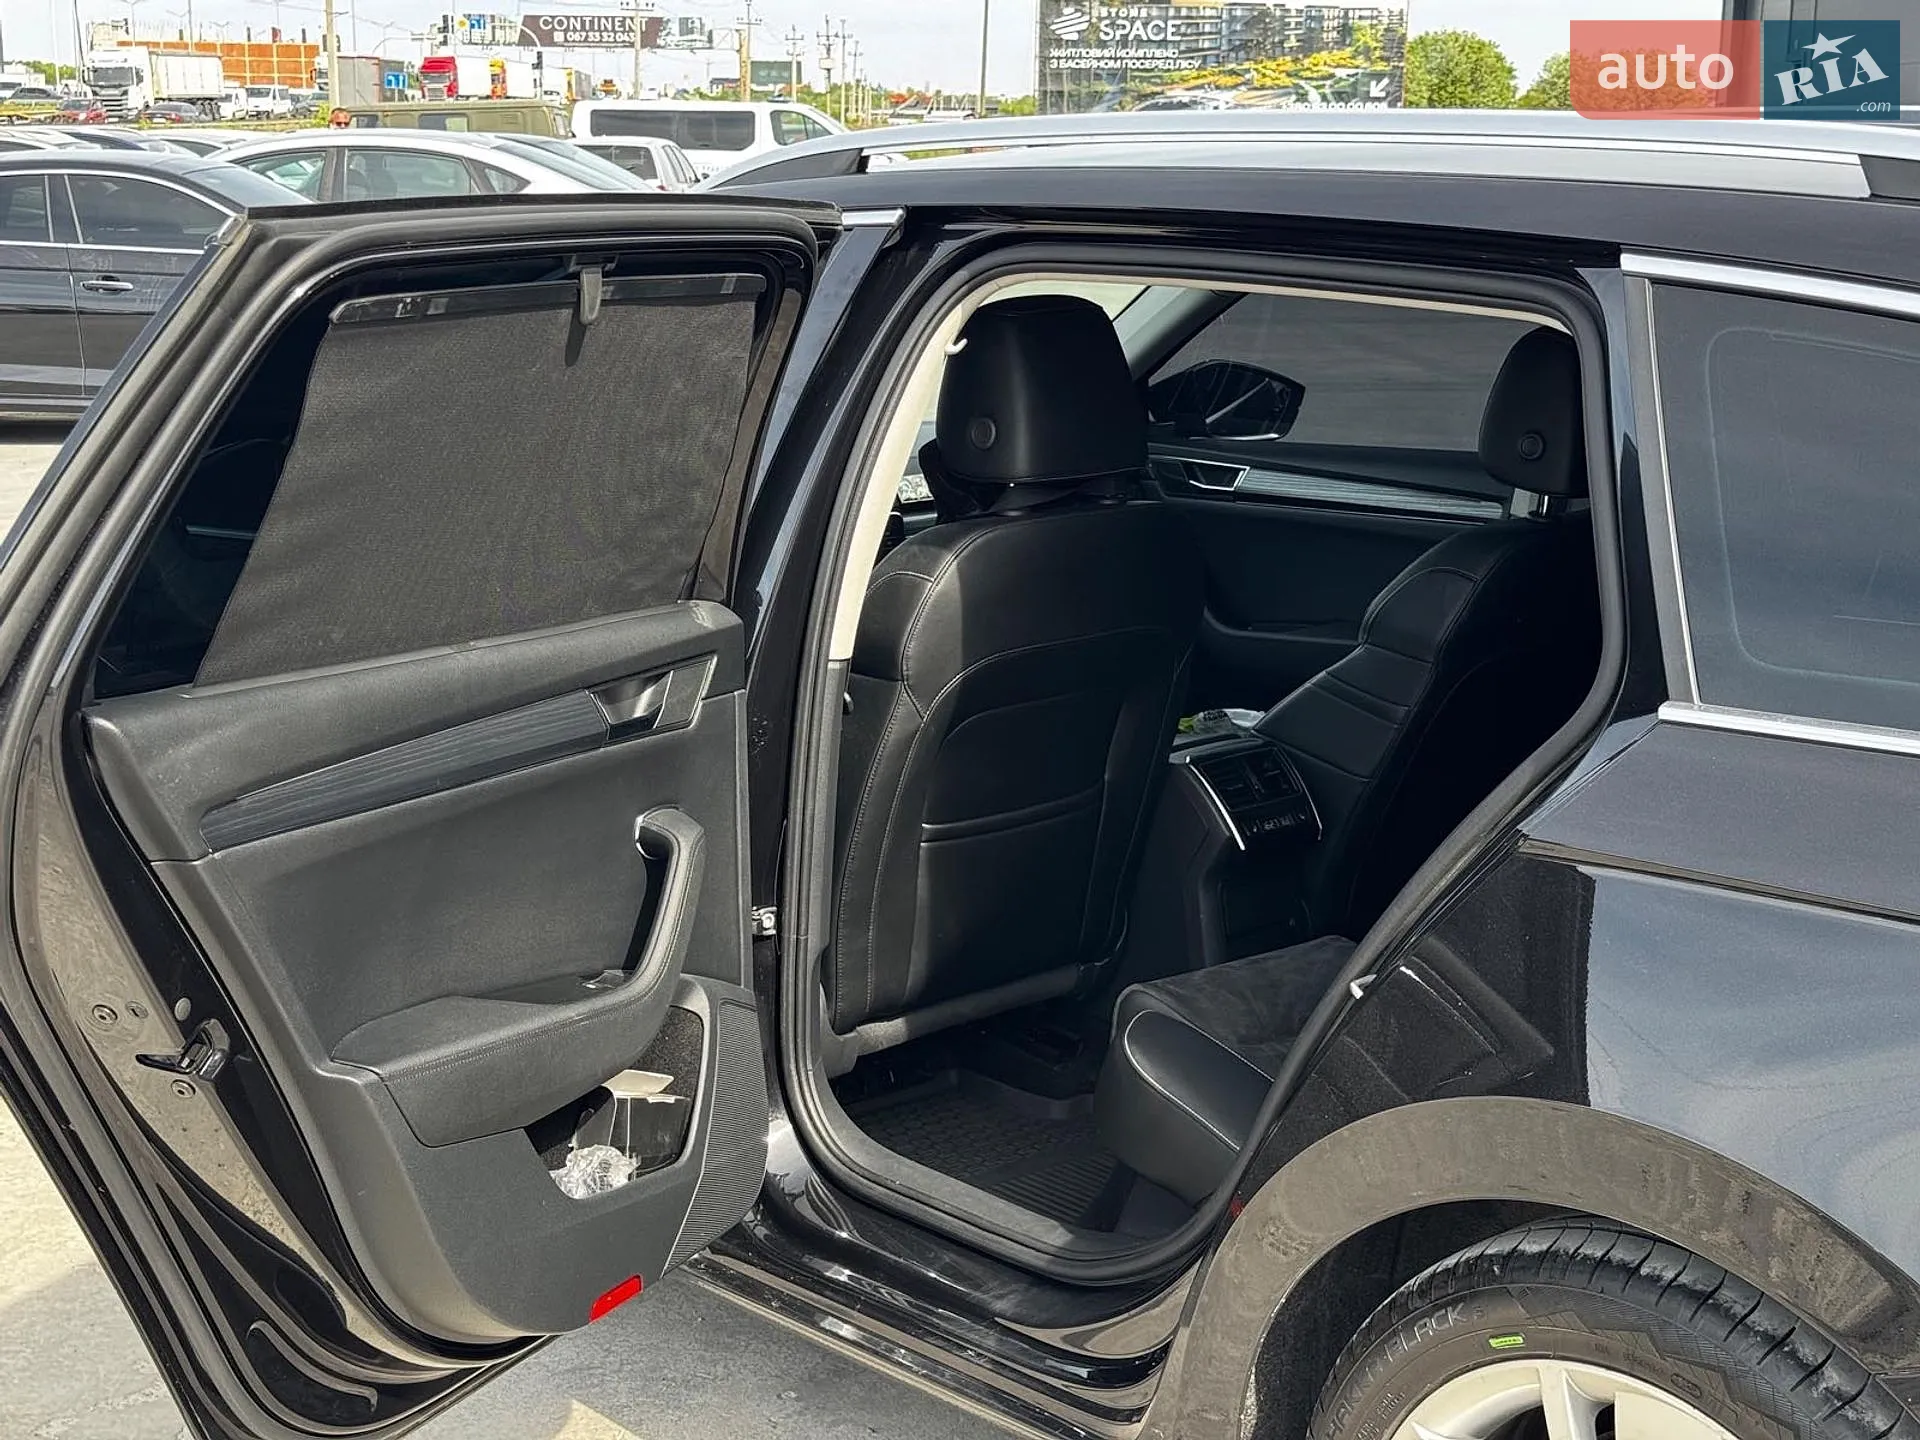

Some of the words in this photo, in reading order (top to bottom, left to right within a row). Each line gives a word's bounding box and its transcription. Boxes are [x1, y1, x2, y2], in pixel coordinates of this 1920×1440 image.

[539, 16, 649, 32] CONTINENT
[1100, 20, 1182, 41] SPACE
[566, 32, 586, 42] 067
[1050, 48, 1115, 58] ЖИТЛОВИЙ
[1059, 58, 1121, 69] БАСЕЙНОМ
[1122, 59, 1175, 69] ПОСЕРЕД
